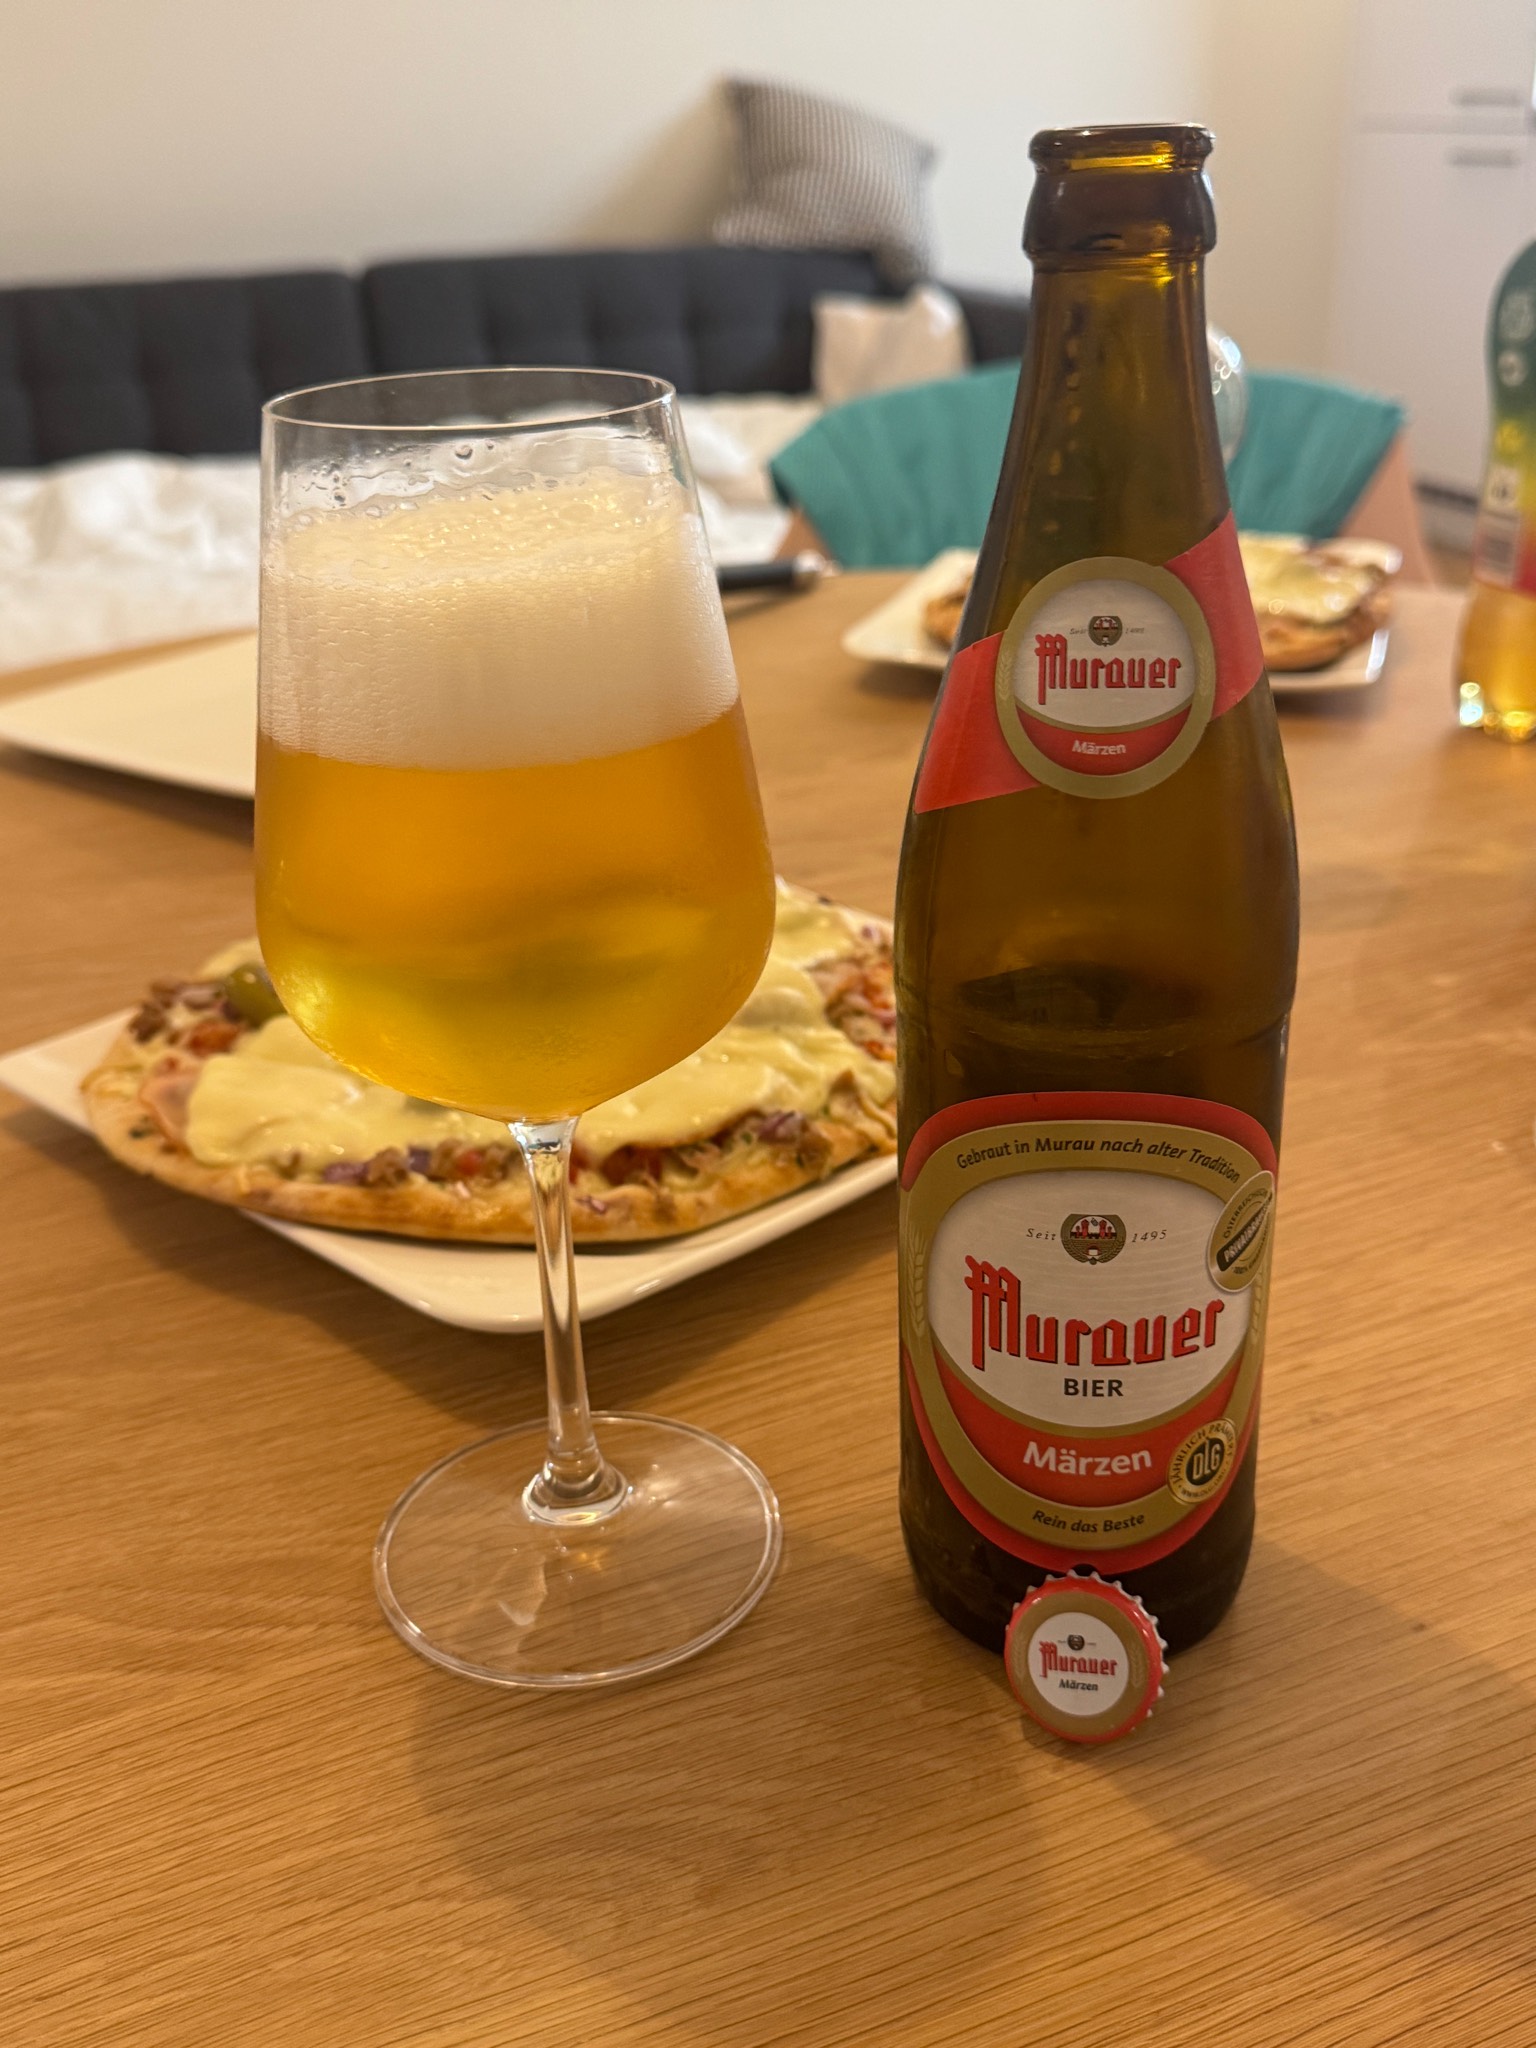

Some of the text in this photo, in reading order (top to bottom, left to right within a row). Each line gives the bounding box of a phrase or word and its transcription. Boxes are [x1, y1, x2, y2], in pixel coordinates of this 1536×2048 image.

[1034, 633, 1182, 705] Murauer
[1072, 739, 1127, 756] Märzen
[956, 1137, 1240, 1184] Gebraut in Murau nach alter Tradition
[1026, 1227, 1168, 1243] Seit 1495
[964, 1254, 1225, 1372] Murauer
[1063, 1377, 1124, 1397] BIER
[1023, 1440, 1152, 1476] Märzen
[1192, 1439, 1222, 1480] DLG
[1032, 1510, 1145, 1533] Rein das Beste
[1038, 1640, 1118, 1679] Murauer
[1058, 1678, 1099, 1692] Märzen
